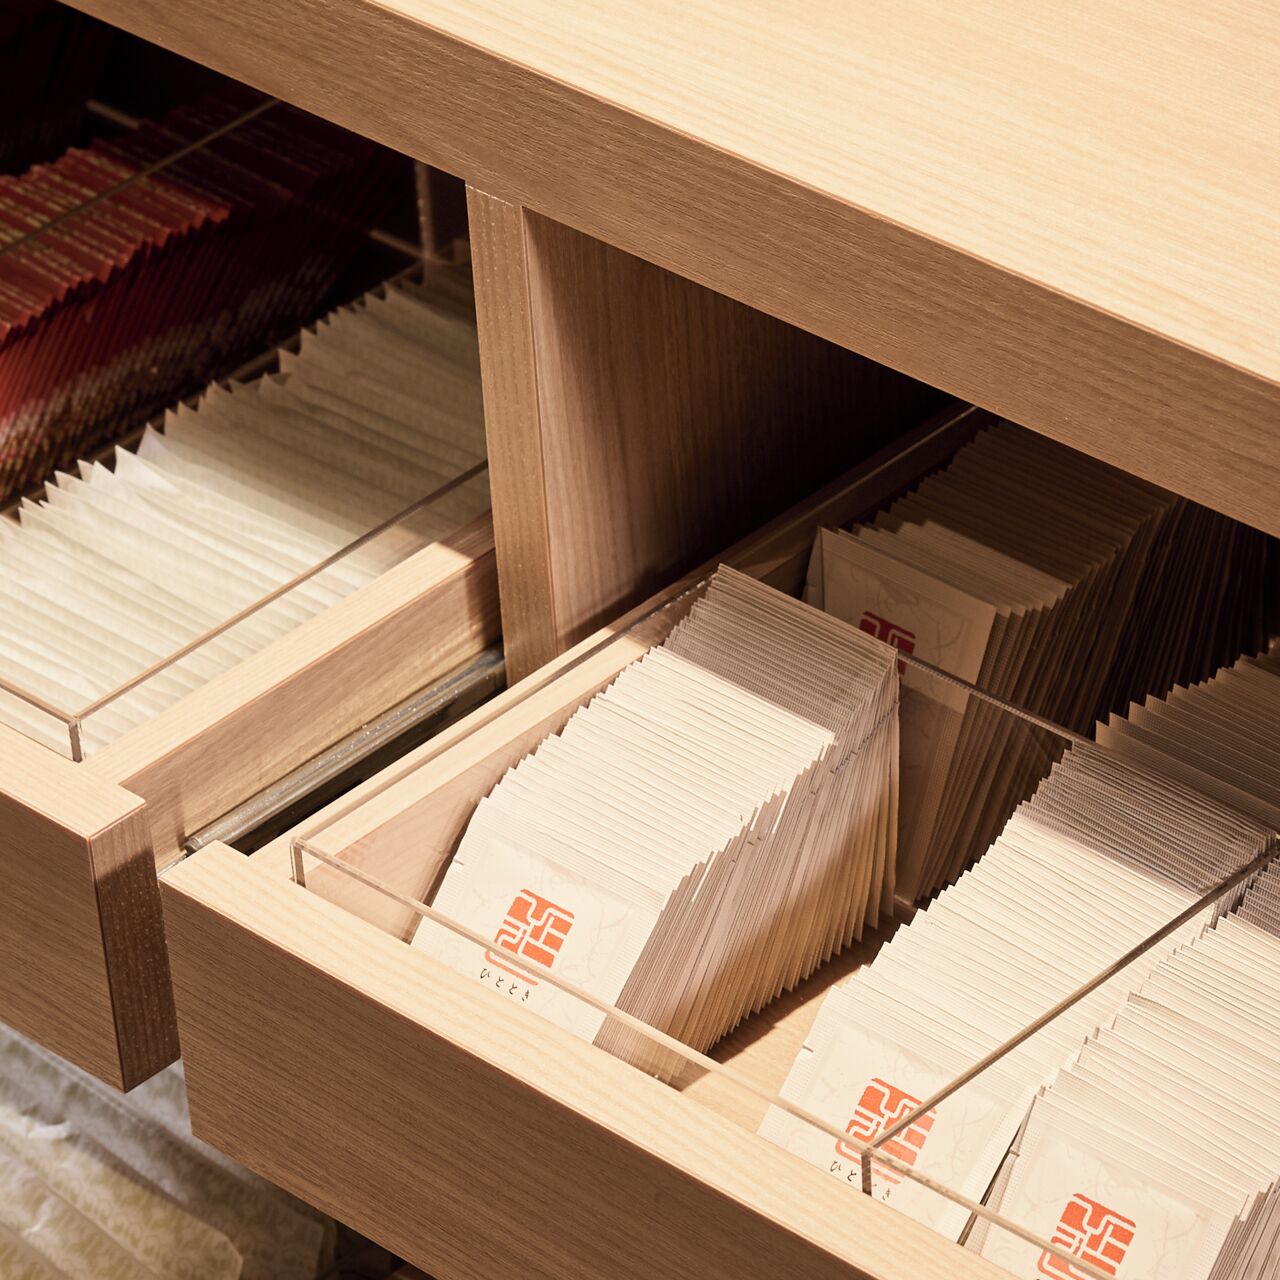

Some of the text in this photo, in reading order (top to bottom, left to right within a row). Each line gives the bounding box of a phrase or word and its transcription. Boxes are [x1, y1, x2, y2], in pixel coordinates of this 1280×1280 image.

[479, 967, 530, 1002] ひととき
[829, 1160, 892, 1201] ひとき
